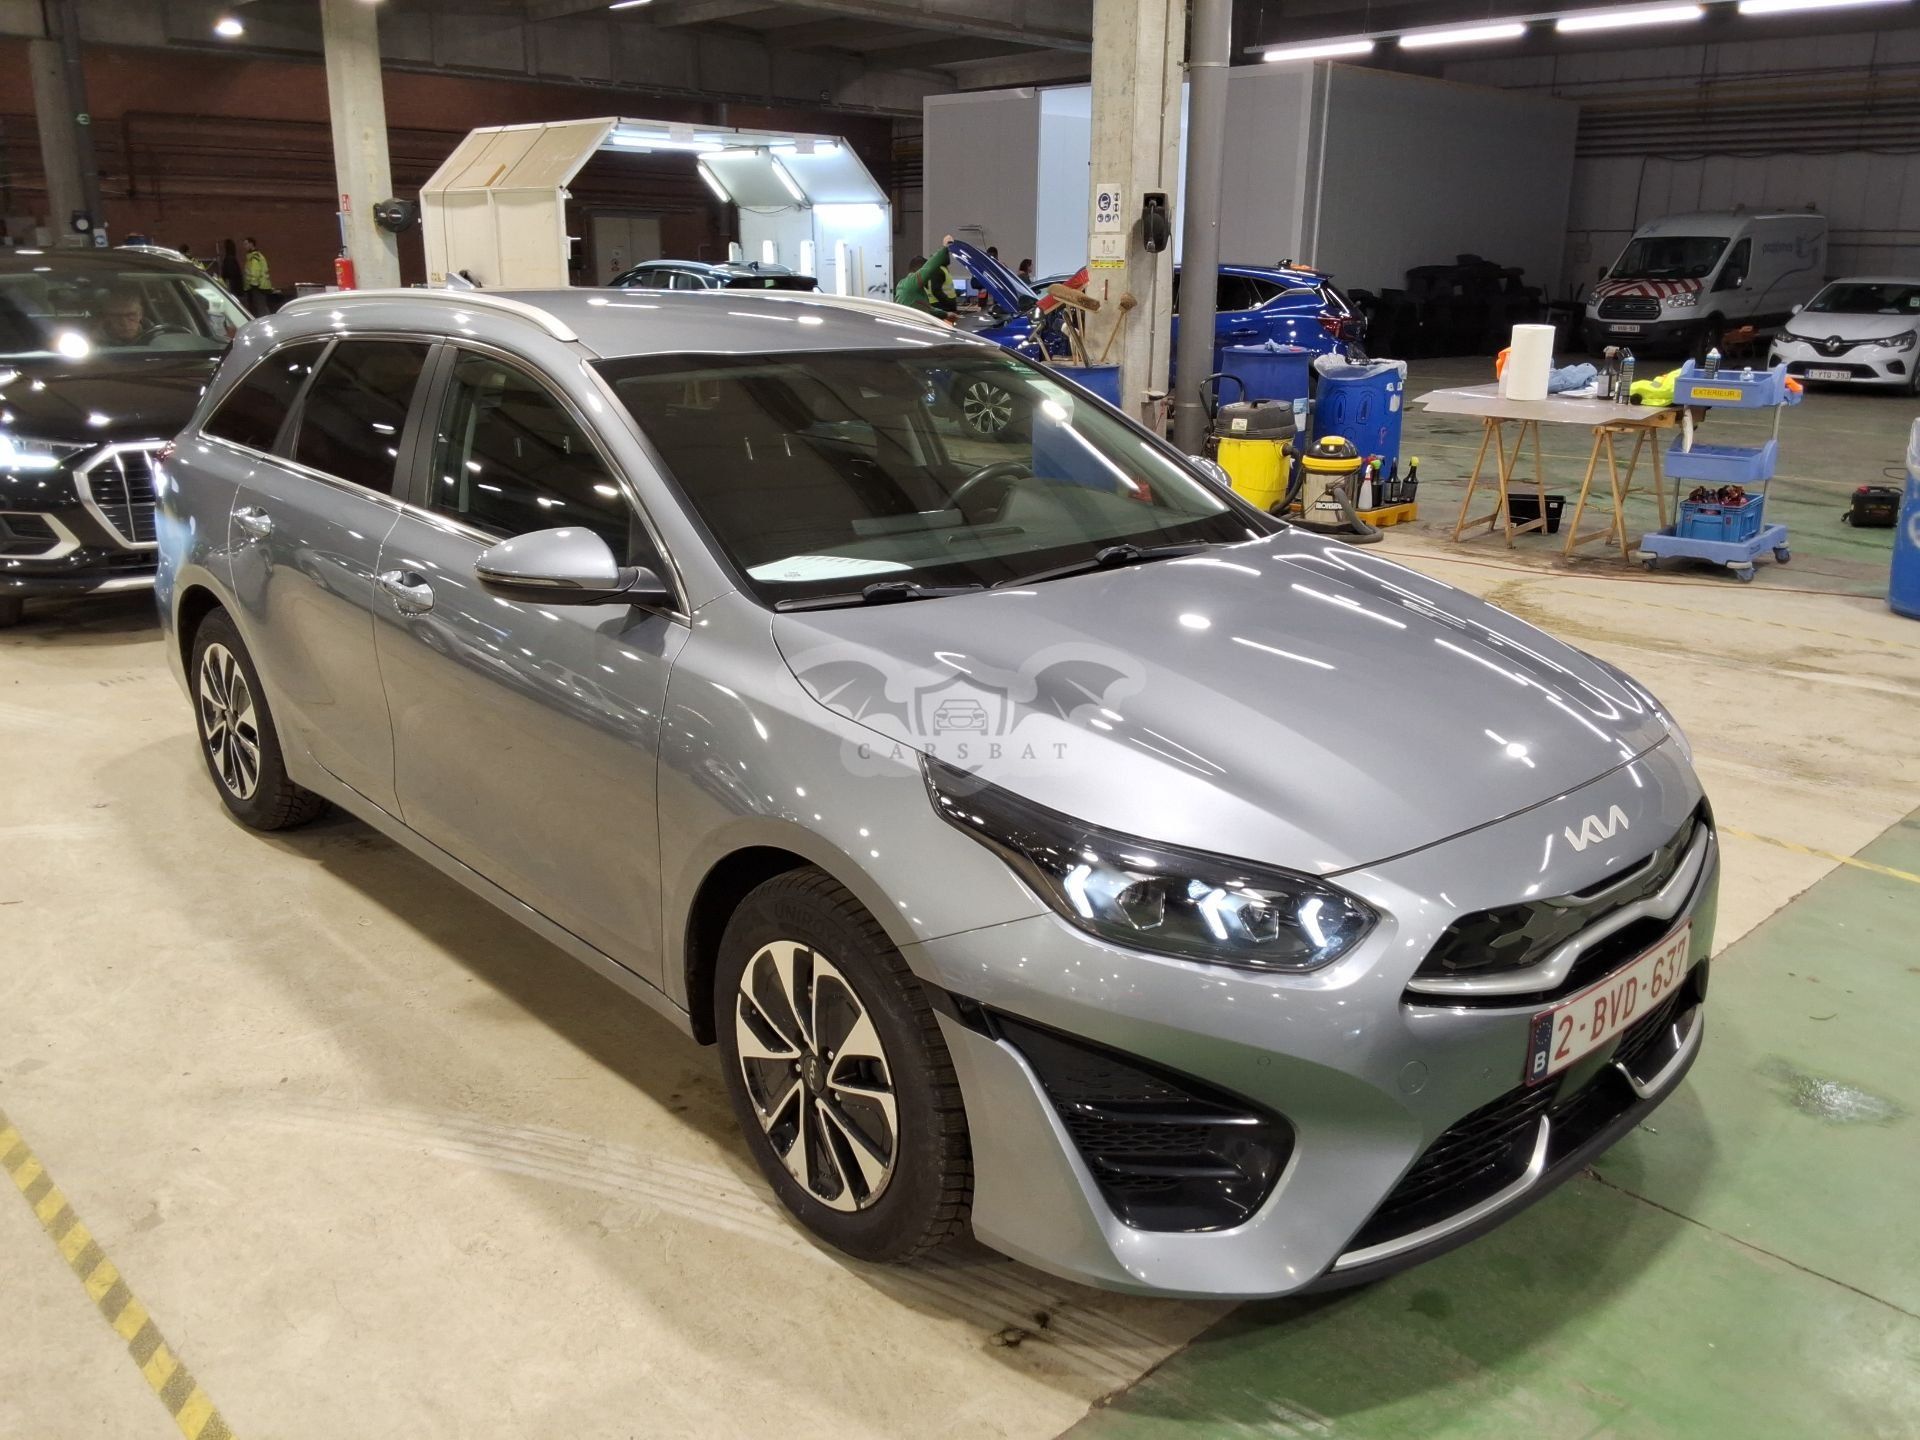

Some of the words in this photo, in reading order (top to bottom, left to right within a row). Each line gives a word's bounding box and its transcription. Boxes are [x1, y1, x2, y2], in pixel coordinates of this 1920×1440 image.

[1564, 804, 1629, 852] KIA
[1554, 935, 1687, 1061] 2-BVD-637
[1533, 1051, 1546, 1074] B
